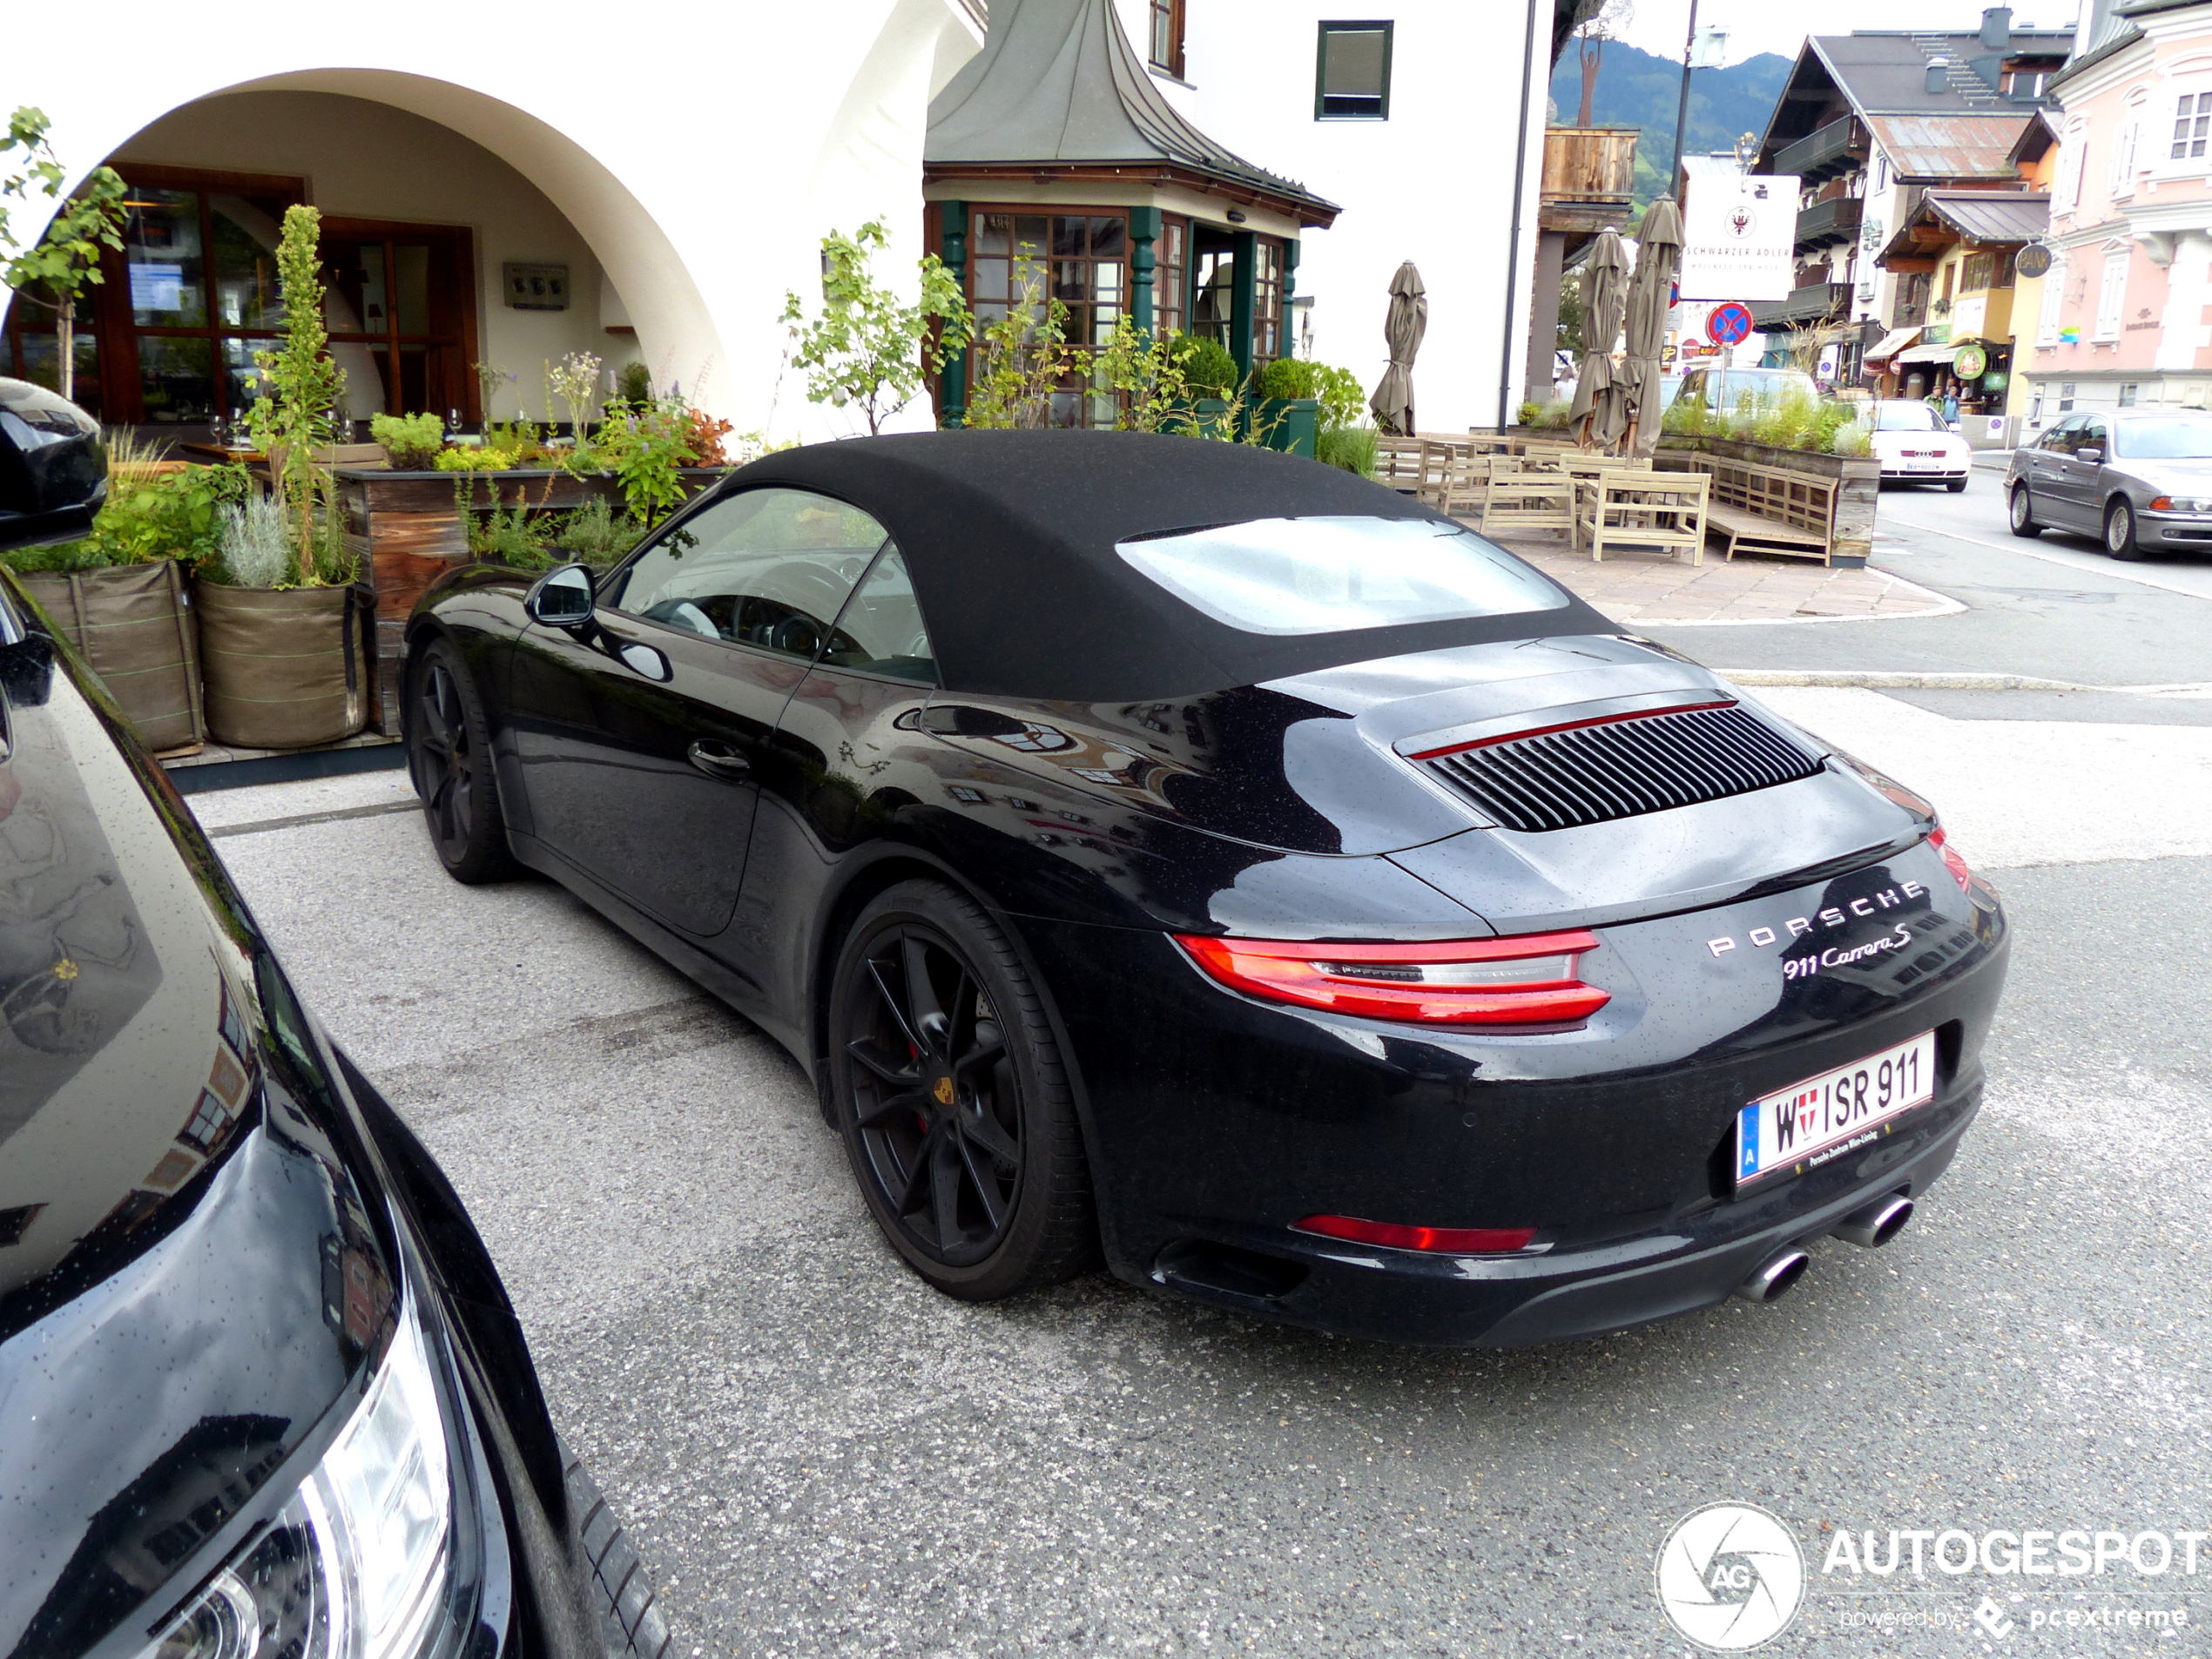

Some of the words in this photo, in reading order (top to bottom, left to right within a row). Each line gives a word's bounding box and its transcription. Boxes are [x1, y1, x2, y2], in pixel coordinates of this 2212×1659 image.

[1686, 246, 1750, 256] SCHWARZER
[1757, 248, 1790, 257] ADLER
[2019, 251, 2051, 269] BANK
[1707, 880, 1924, 958] PORSCHE
[1784, 955, 1817, 980] 911
[1821, 936, 1894, 968] Carrera
[1893, 922, 1912, 948] S
[1776, 1096, 1797, 1153] W
[1824, 1069, 1869, 1133] ISR
[1878, 1047, 1919, 1109] 911
[1744, 1149, 1755, 1165] A
[1809, 1150, 1830, 1167] Porsche
[1829, 1143, 1849, 1158] Zentrum
